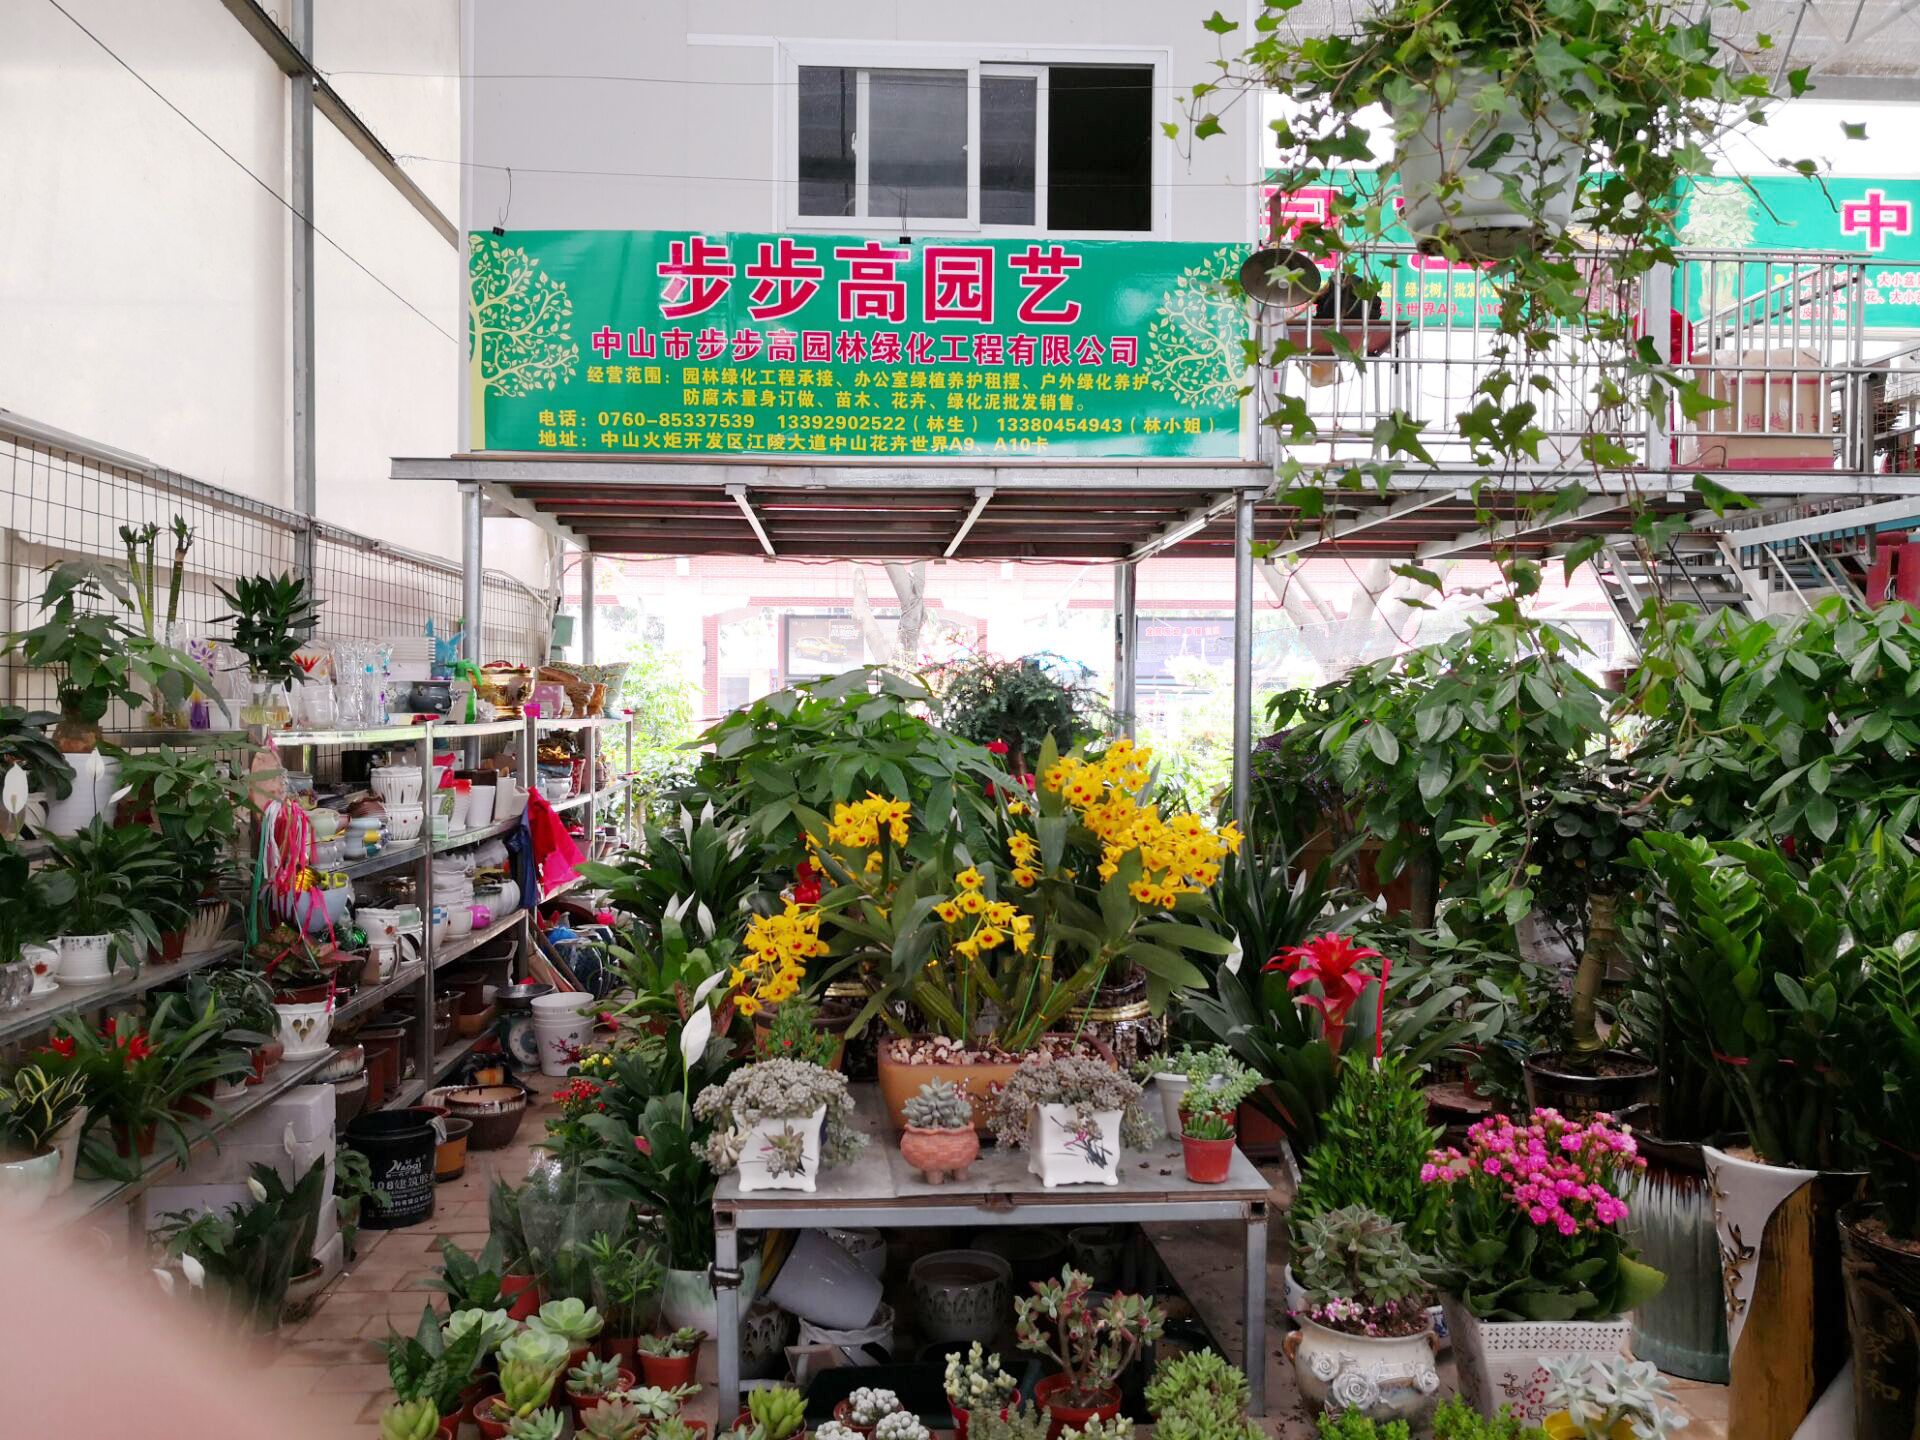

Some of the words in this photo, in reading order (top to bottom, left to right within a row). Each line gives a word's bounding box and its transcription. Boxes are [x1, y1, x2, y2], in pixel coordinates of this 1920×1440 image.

[1841, 189, 1912, 251] 中
[657, 237, 1082, 324] 步步高园艺
[591, 326, 1139, 367] 中山市步步高园林绿化工程有限公司
